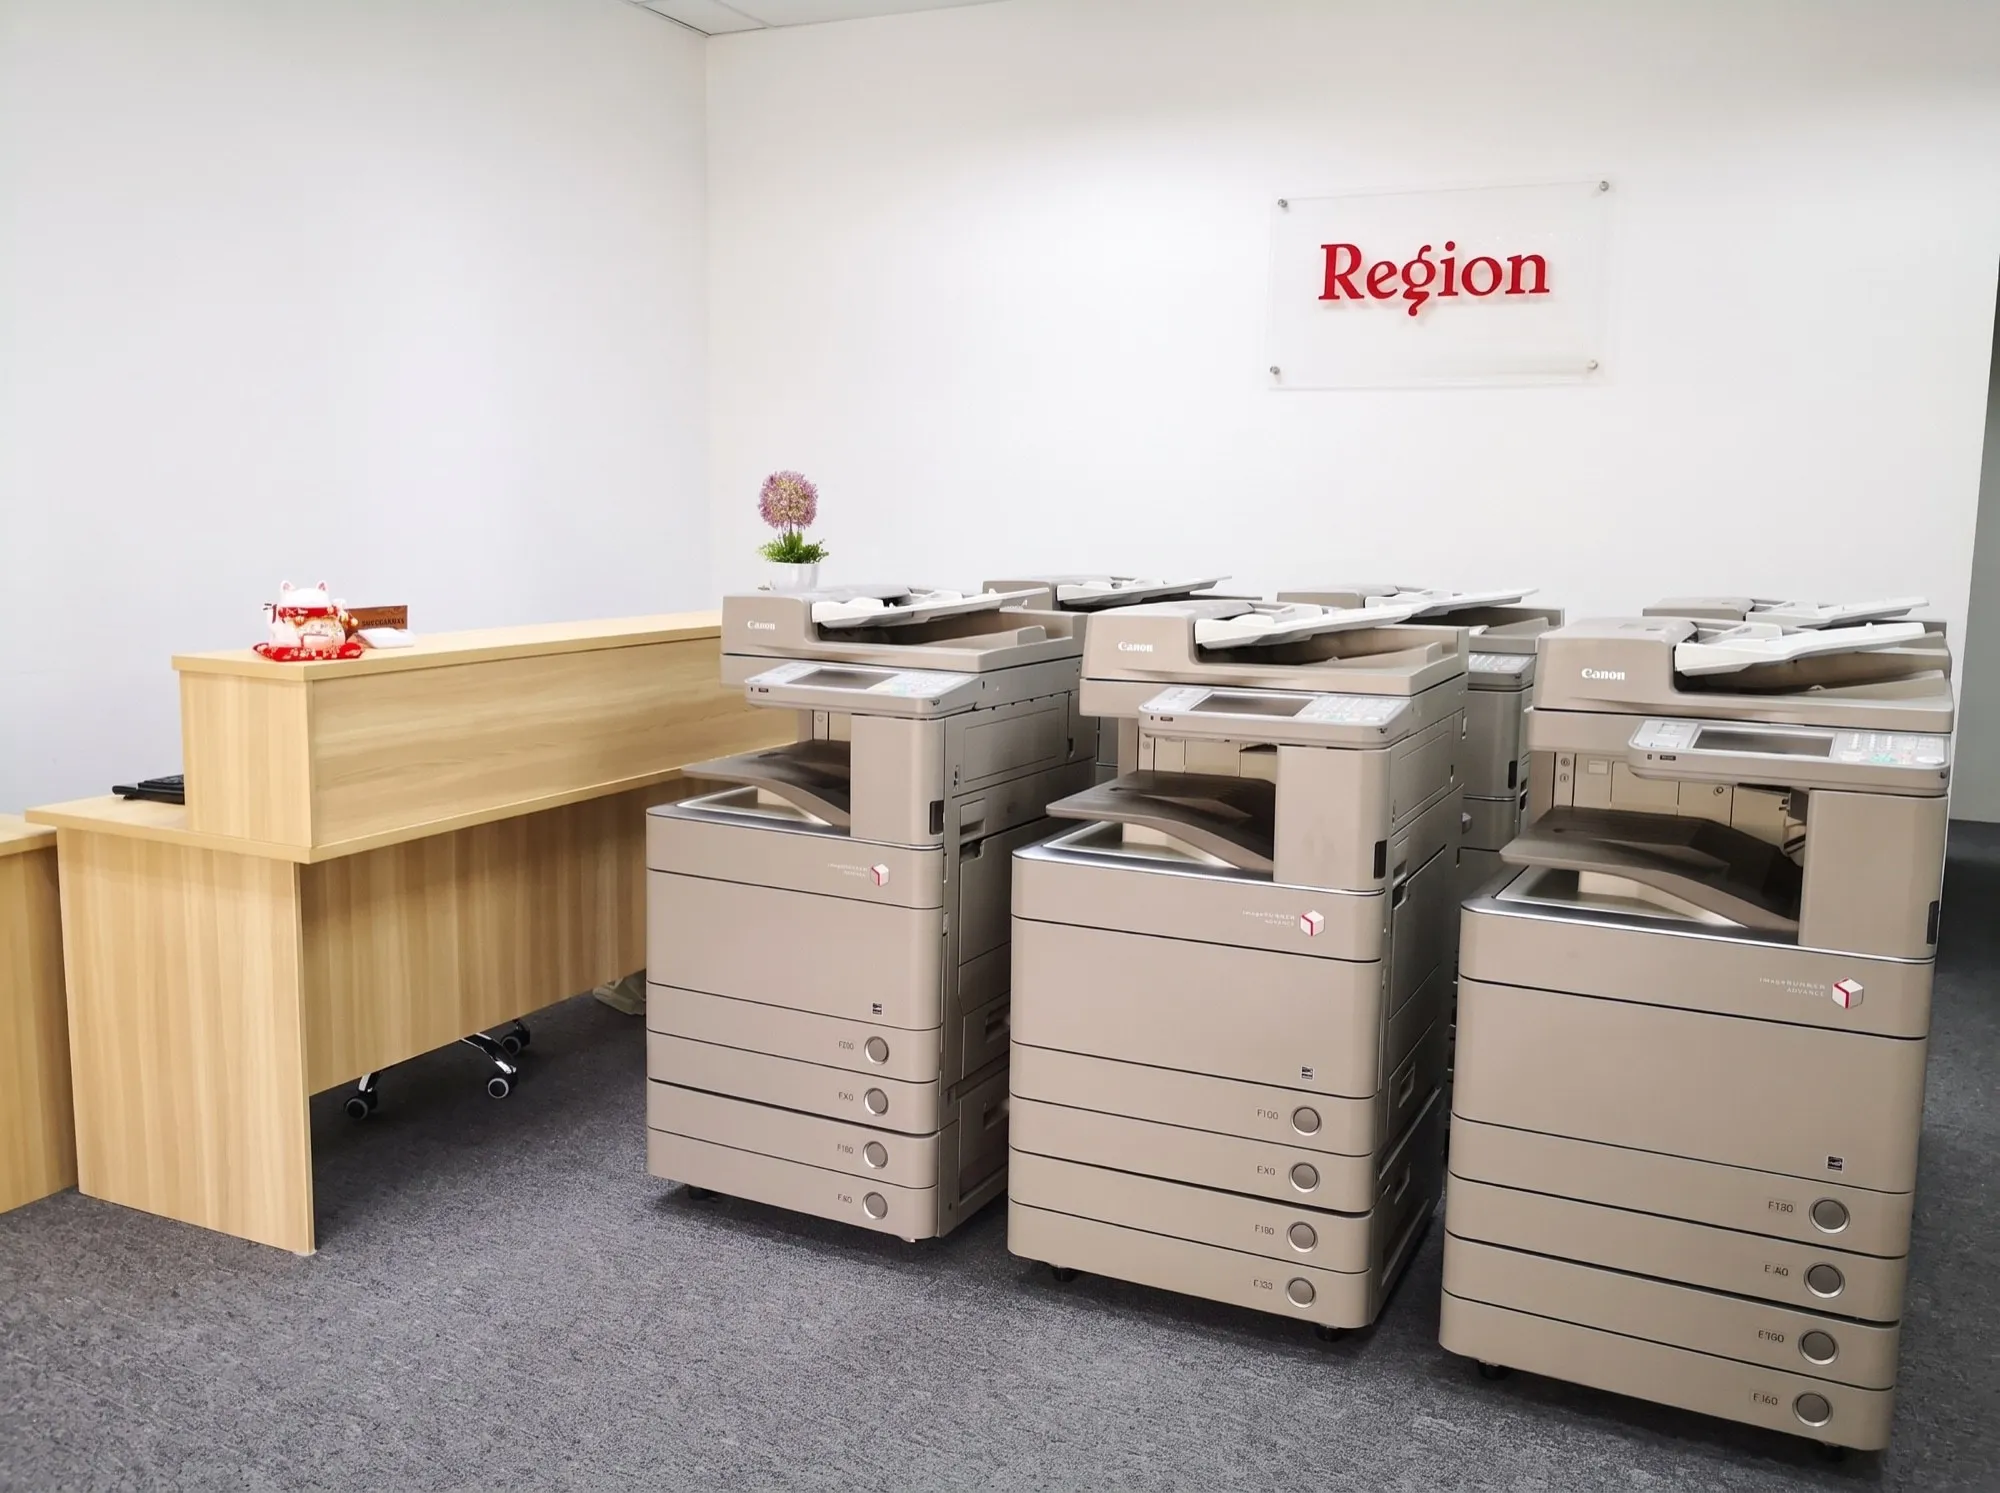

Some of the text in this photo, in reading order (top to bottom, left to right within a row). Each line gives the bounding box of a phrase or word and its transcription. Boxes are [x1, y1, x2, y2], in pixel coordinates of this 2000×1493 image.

[1318, 240, 1551, 317] Region
[747, 620, 775, 630] Canon
[1118, 641, 1153, 652] Canon
[1581, 667, 1626, 681] Canon
